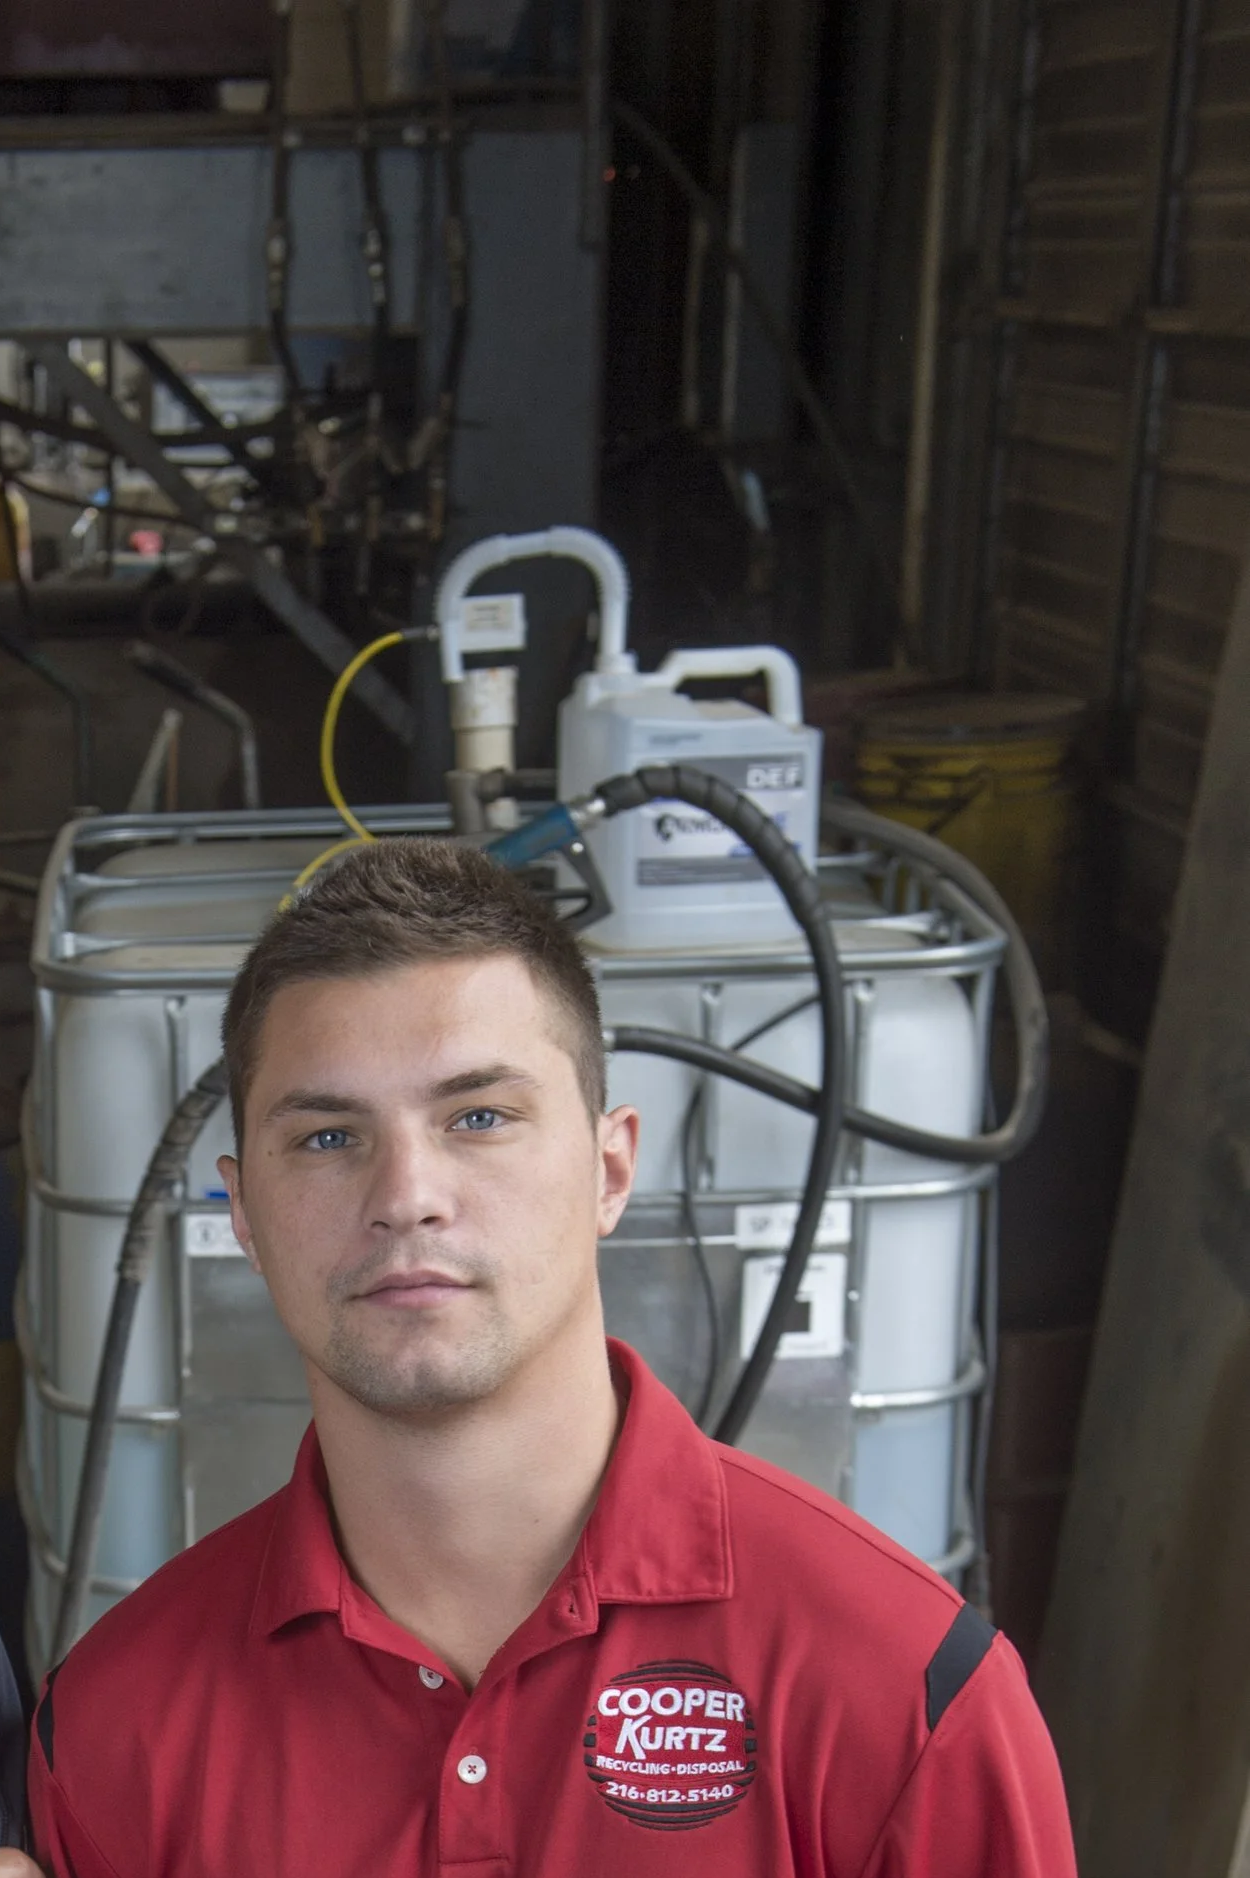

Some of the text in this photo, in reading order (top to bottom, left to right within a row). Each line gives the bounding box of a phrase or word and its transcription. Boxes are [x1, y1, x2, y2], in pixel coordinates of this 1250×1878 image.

[747, 765, 800, 788] DEF
[598, 1687, 745, 1722] COOPER
[614, 1715, 727, 1760] KURTZ
